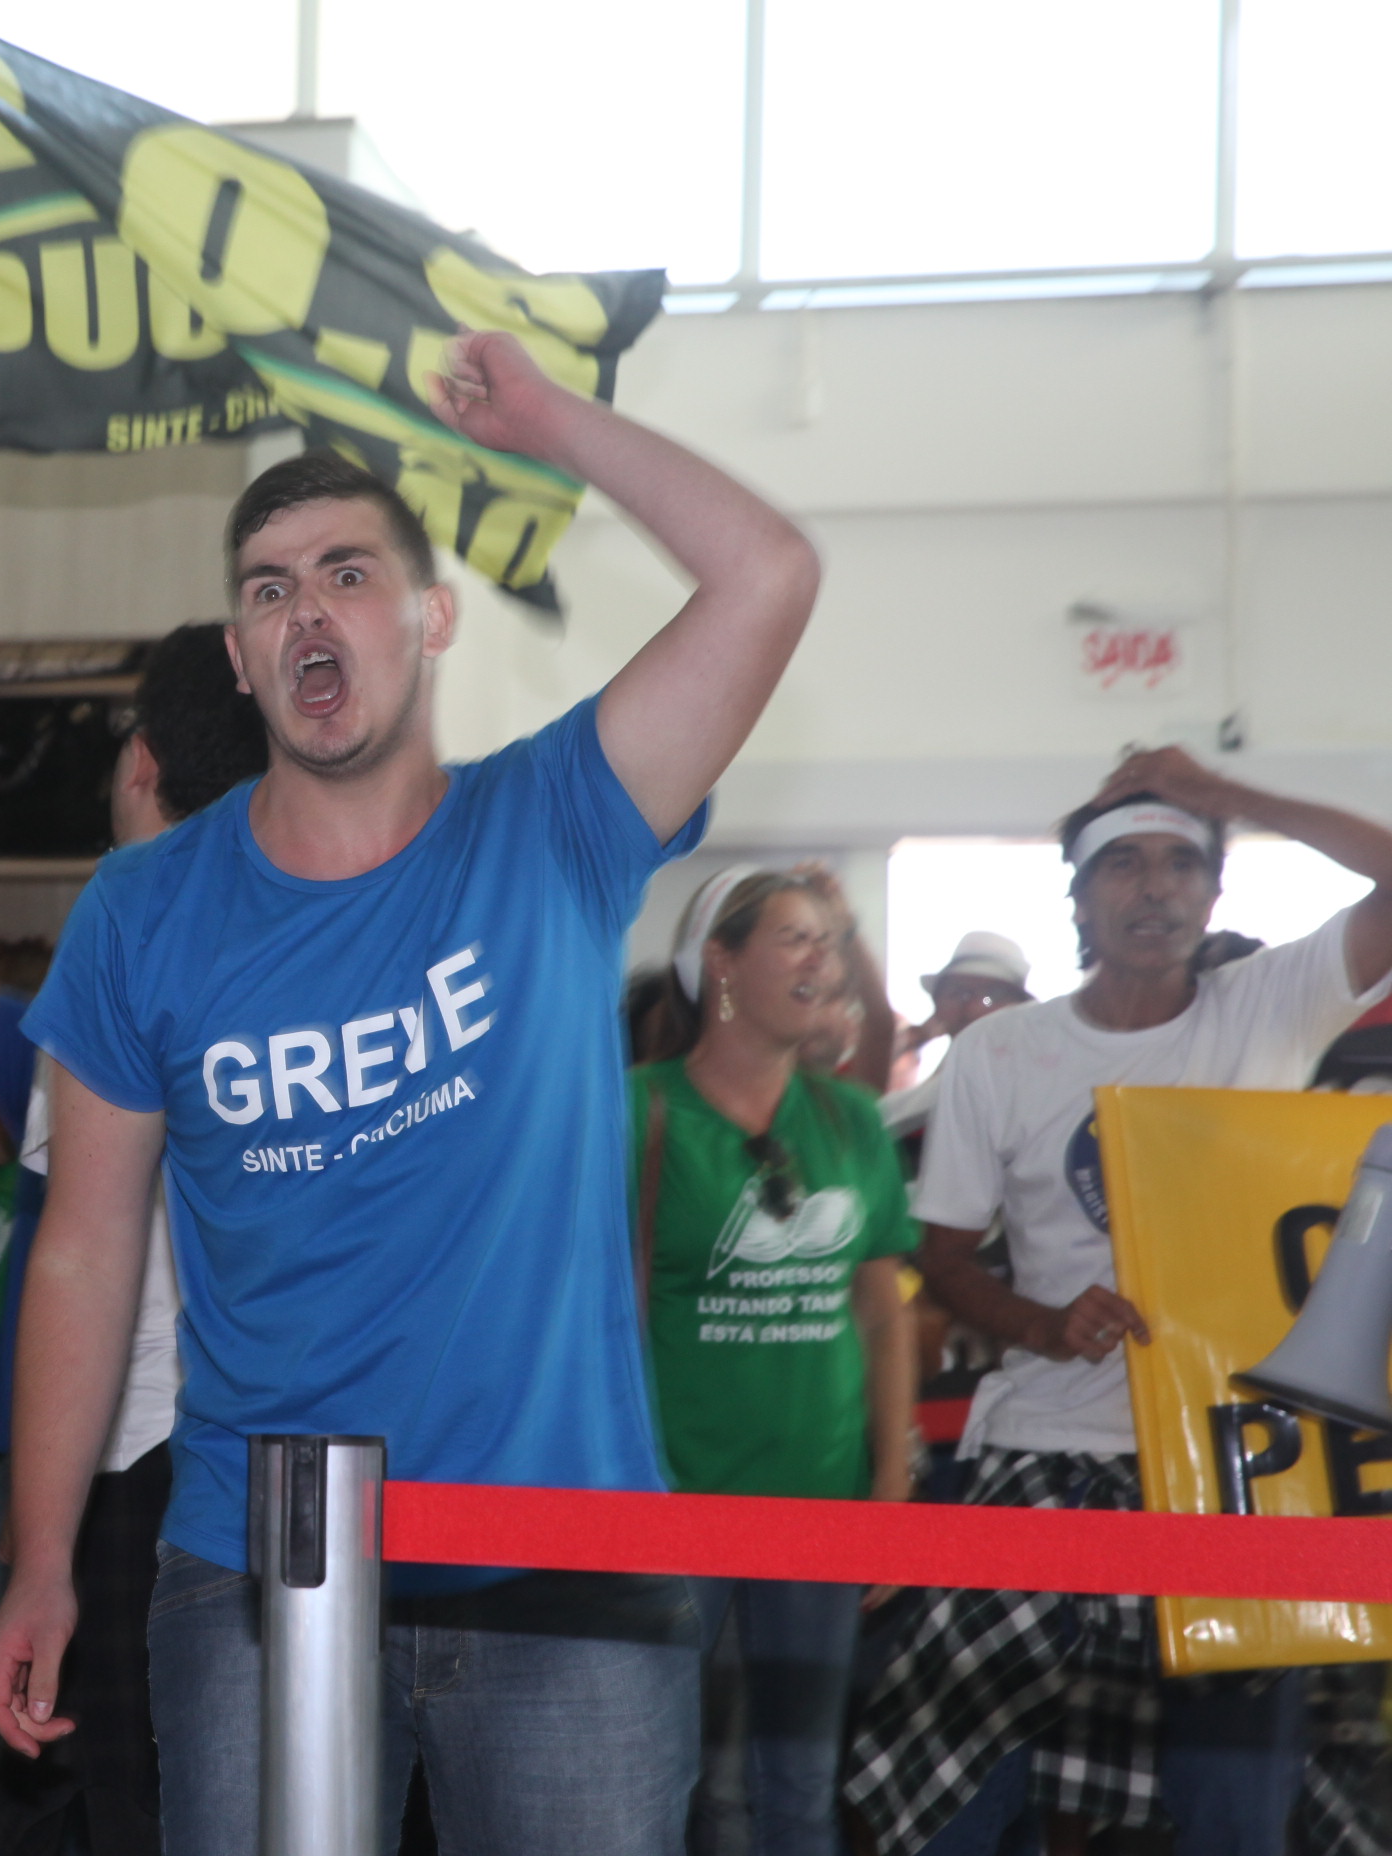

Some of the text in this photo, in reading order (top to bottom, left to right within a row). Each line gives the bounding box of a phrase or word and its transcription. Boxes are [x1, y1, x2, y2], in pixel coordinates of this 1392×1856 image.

[107, 404, 203, 453] SINTE
[203, 948, 493, 1126] GREVE
[242, 1143, 325, 1173] SINTE
[728, 1264, 845, 1288] PROFESSO
[697, 1295, 794, 1315] LUTANDO
